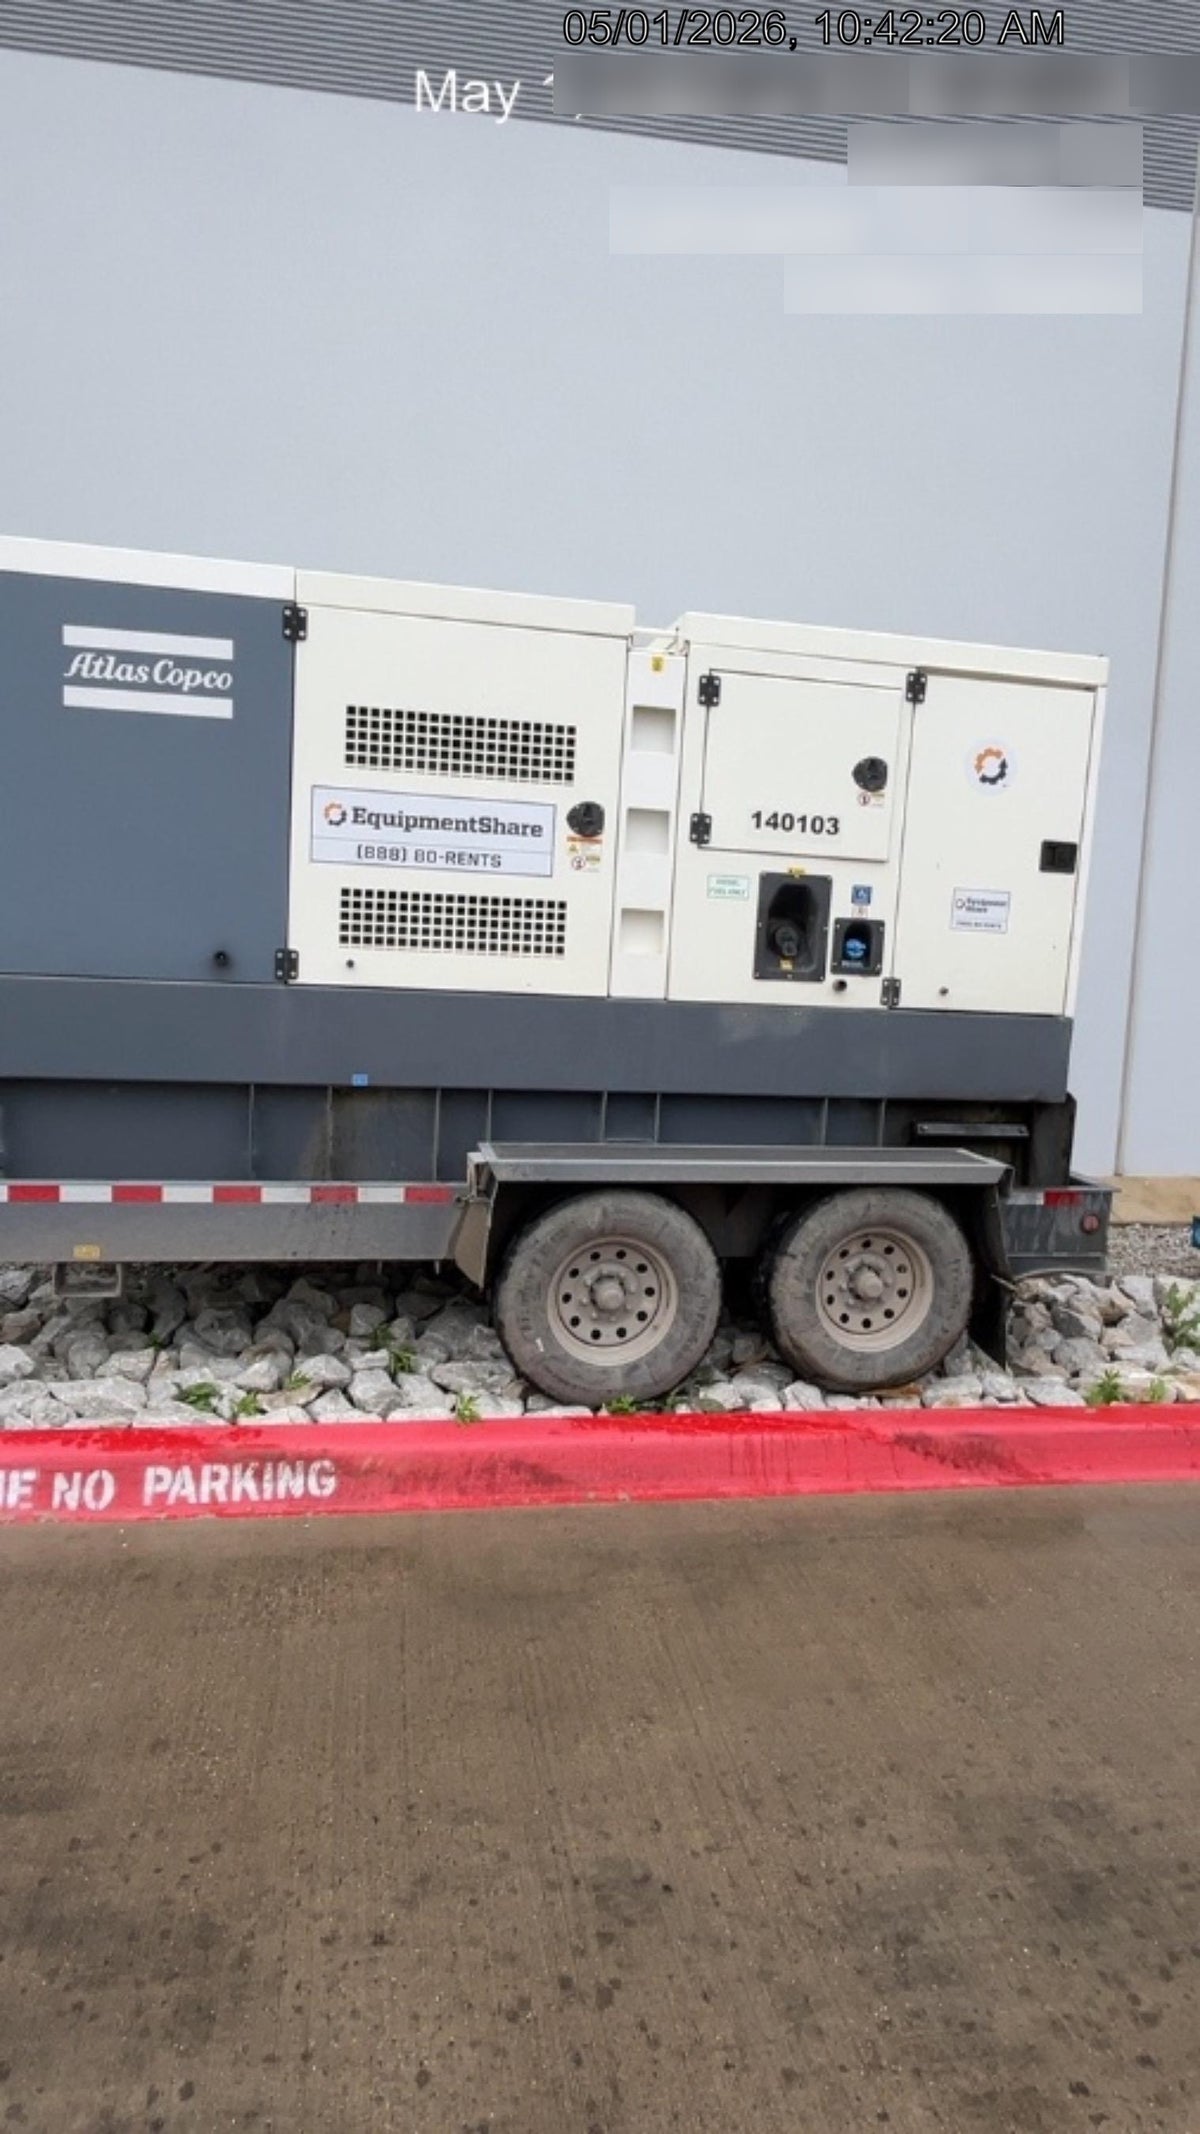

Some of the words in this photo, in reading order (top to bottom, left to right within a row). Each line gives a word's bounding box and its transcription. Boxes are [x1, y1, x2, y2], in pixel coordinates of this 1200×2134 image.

[64, 651, 150, 684] Atlas
[152, 658, 233, 692] Copco
[351, 806, 544, 838] EquipmentShare
[751, 810, 840, 836] 140103
[357, 843, 407, 863] (888)
[413, 848, 502, 868] 80-RENTS
[51, 1469, 115, 1511] NO
[142, 1458, 337, 1507] PARKING
